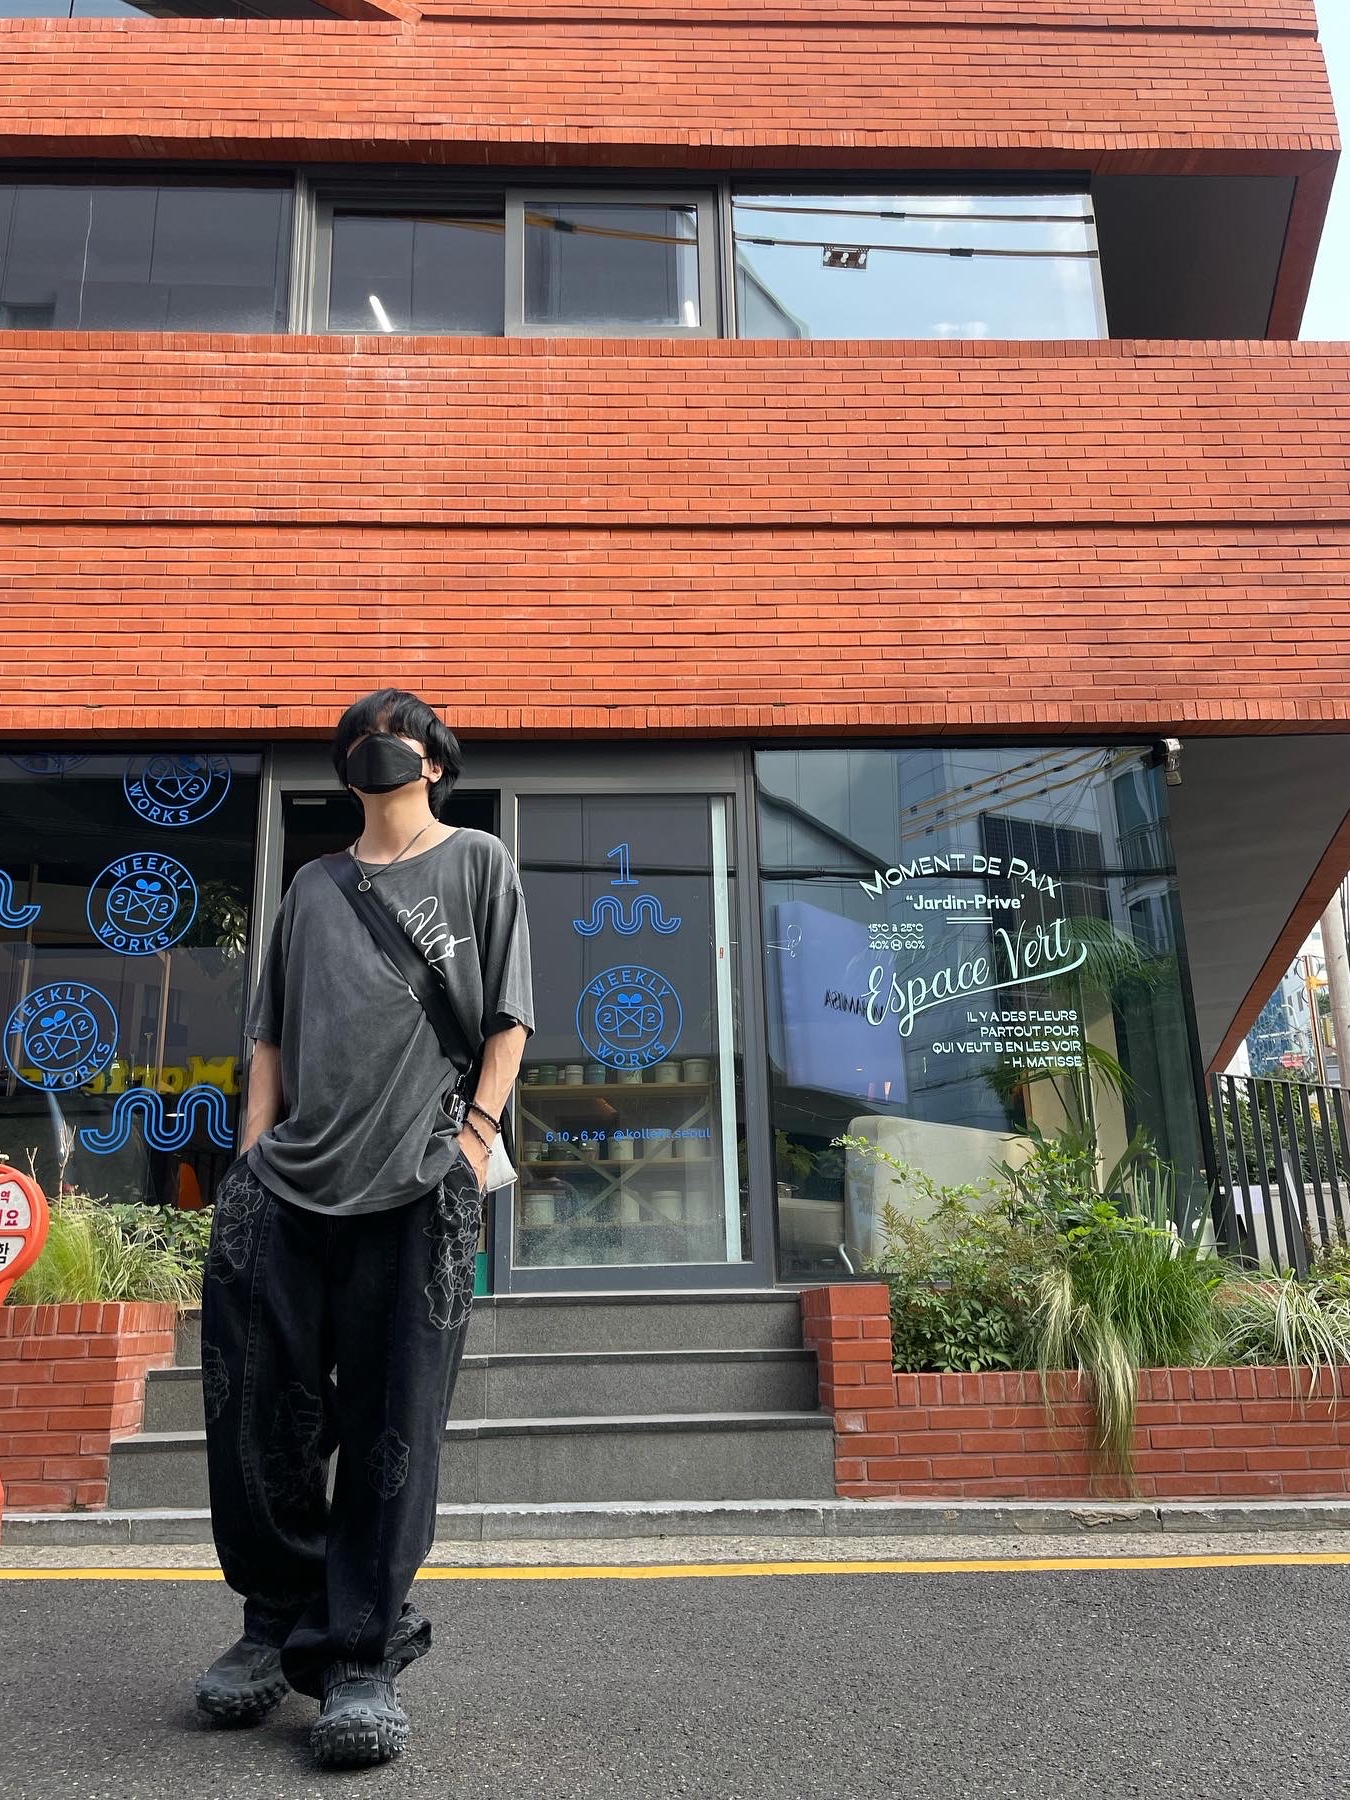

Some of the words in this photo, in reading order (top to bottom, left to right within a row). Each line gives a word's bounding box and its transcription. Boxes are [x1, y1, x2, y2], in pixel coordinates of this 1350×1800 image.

[128, 782, 189, 822] WORKS
[109, 857, 192, 892] WEEKLY
[607, 843, 640, 886] 1
[858, 854, 966, 901] MOMENT
[972, 856, 1002, 876] DE
[1007, 858, 1063, 899] PAIX
[115, 894, 126, 905] 2
[158, 903, 169, 914] 2
[98, 921, 170, 952] WORKS
[900, 923, 924, 933] 25°C
[869, 940, 889, 950] 40%
[905, 940, 926, 950] 60%
[588, 970, 671, 998] WEEKLY
[861, 957, 990, 1038] Espace
[995, 919, 1071, 979] Vert
[9, 987, 92, 1035] WEEKLY
[602, 1012, 612, 1023] 2
[647, 1012, 656, 1023] 2
[1002, 1010, 1027, 1022] DES
[1029, 1010, 1078, 1022] FLEURS
[34, 1042, 45, 1054] 2
[77, 1020, 89, 1031] 2
[980, 1025, 1041, 1037] PARTOUT
[1044, 1025, 1080, 1037] POUR
[596, 1042, 668, 1066] WORKS
[932, 1042, 954, 1054] QUI
[956, 1042, 991, 1053] VEUT
[1026, 1041, 1049, 1053] LES
[1051, 1041, 1081, 1052] VOIR
[42, 1042, 111, 1087] WORKS
[1027, 1056, 1083, 1068] MATISSE
[545, 1130, 570, 1142] 6.10
[580, 1130, 606, 1141] 6.26
